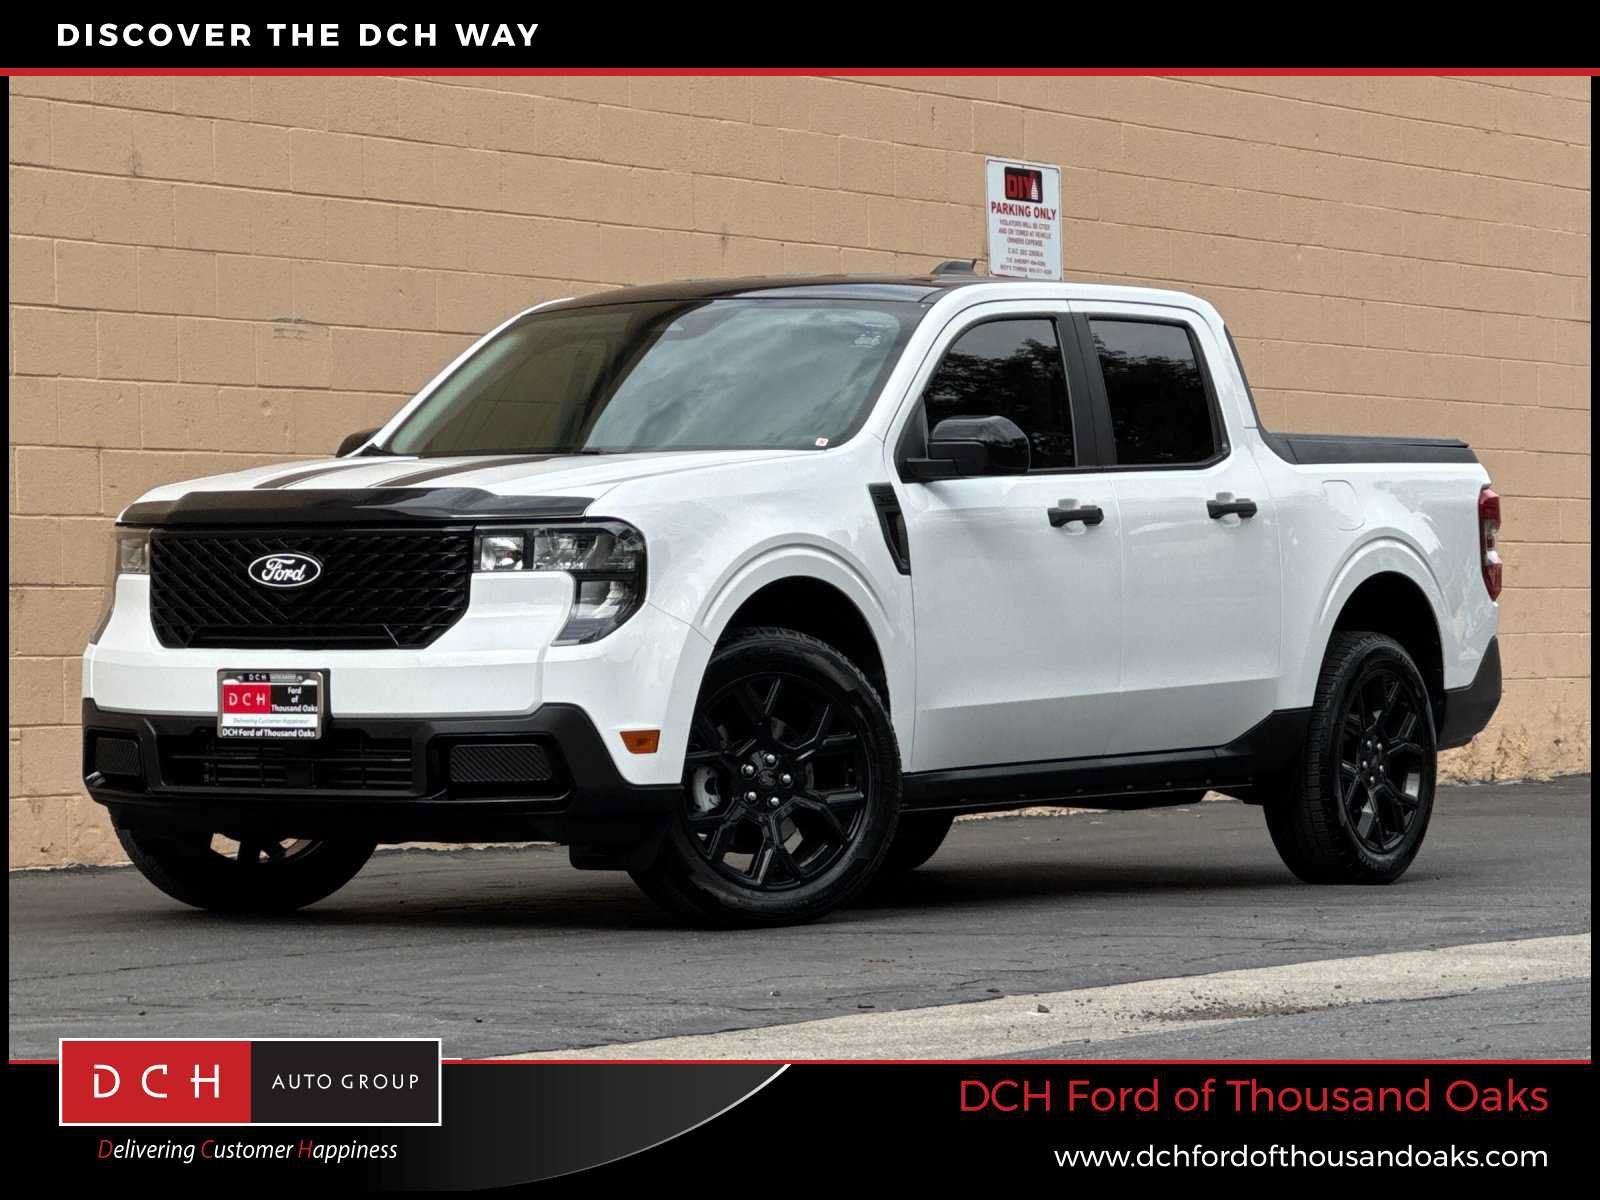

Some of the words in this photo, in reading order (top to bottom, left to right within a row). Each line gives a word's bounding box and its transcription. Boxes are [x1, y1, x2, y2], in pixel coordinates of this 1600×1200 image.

[991, 201, 1031, 218] PARKING
[1034, 206, 1057, 221] ONLY
[261, 558, 306, 581] Ford
[287, 686, 302, 695] Ford
[228, 692, 266, 706] DCH
[291, 695, 299, 703] of
[271, 704, 301, 712] Thousand
[302, 704, 318, 712] Oaks
[223, 729, 238, 737] DCH
[239, 729, 255, 737] Ford
[256, 729, 264, 737] of
[264, 729, 297, 737] Thousand
[298, 729, 315, 738] Oaks
